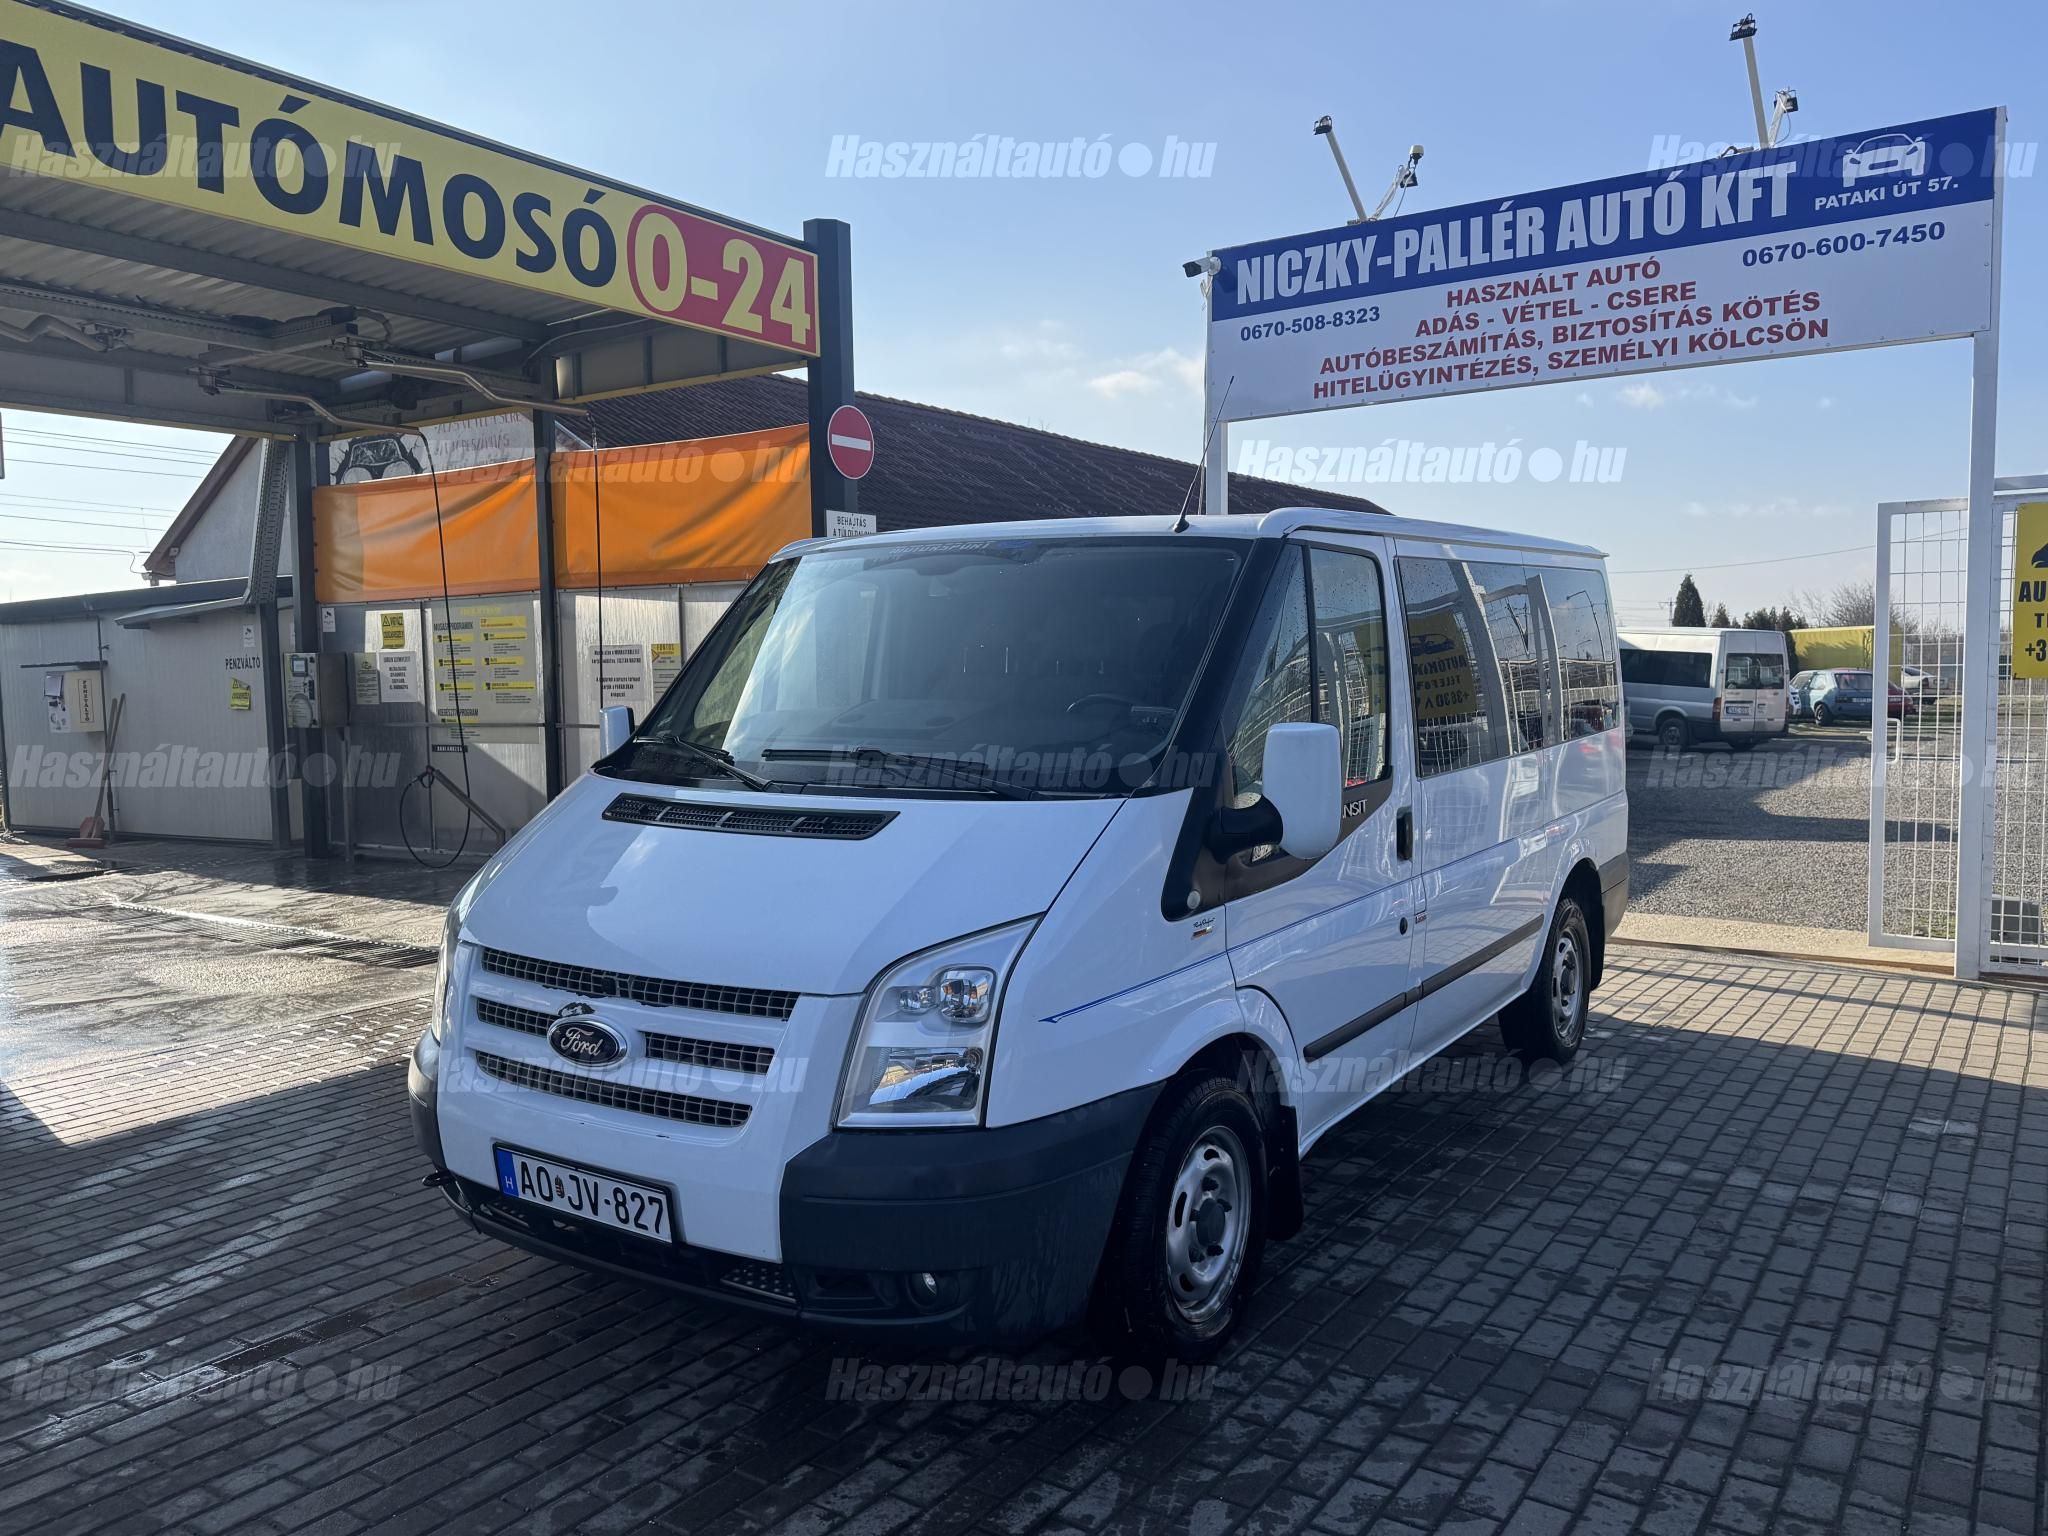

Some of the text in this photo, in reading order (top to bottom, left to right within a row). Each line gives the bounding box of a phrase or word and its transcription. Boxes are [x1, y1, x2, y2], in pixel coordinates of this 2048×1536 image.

[0, 38, 811, 344] AUTÓMOSÓ 0-24
[1814, 175, 1960, 211] PATAKI ÚT 57.
[1237, 161, 1797, 304] NICZKY-PALLÉR AUTÓ KFT
[1742, 221, 1945, 267] 0670-600-7450
[1447, 256, 1661, 308] HASZNÁLT AUTÓ
[1240, 306, 1380, 341] 0670-508-8323
[1320, 289, 1820, 375] AUTÓBESZÁMÍTÁS, BIZTOSÍTÁS KÖTÉS
[1415, 308, 1479, 338] ADÁS
[1502, 298, 1583, 325] VÉTEL
[1607, 281, 1697, 311] CSERE
[1314, 318, 1829, 399] HITELÜGYINTÉZÉS, SZEMÉLYI KÖLCSÖN
[837, 516, 867, 527] BEHAJTÁS
[225, 654, 261, 670] PÉNZVÁLTÓ
[1342, 799, 1368, 819] NSIT
[559, 1026, 605, 1056] Ford
[504, 1175, 515, 1191] H
[520, 1161, 664, 1234] AO JV-827
